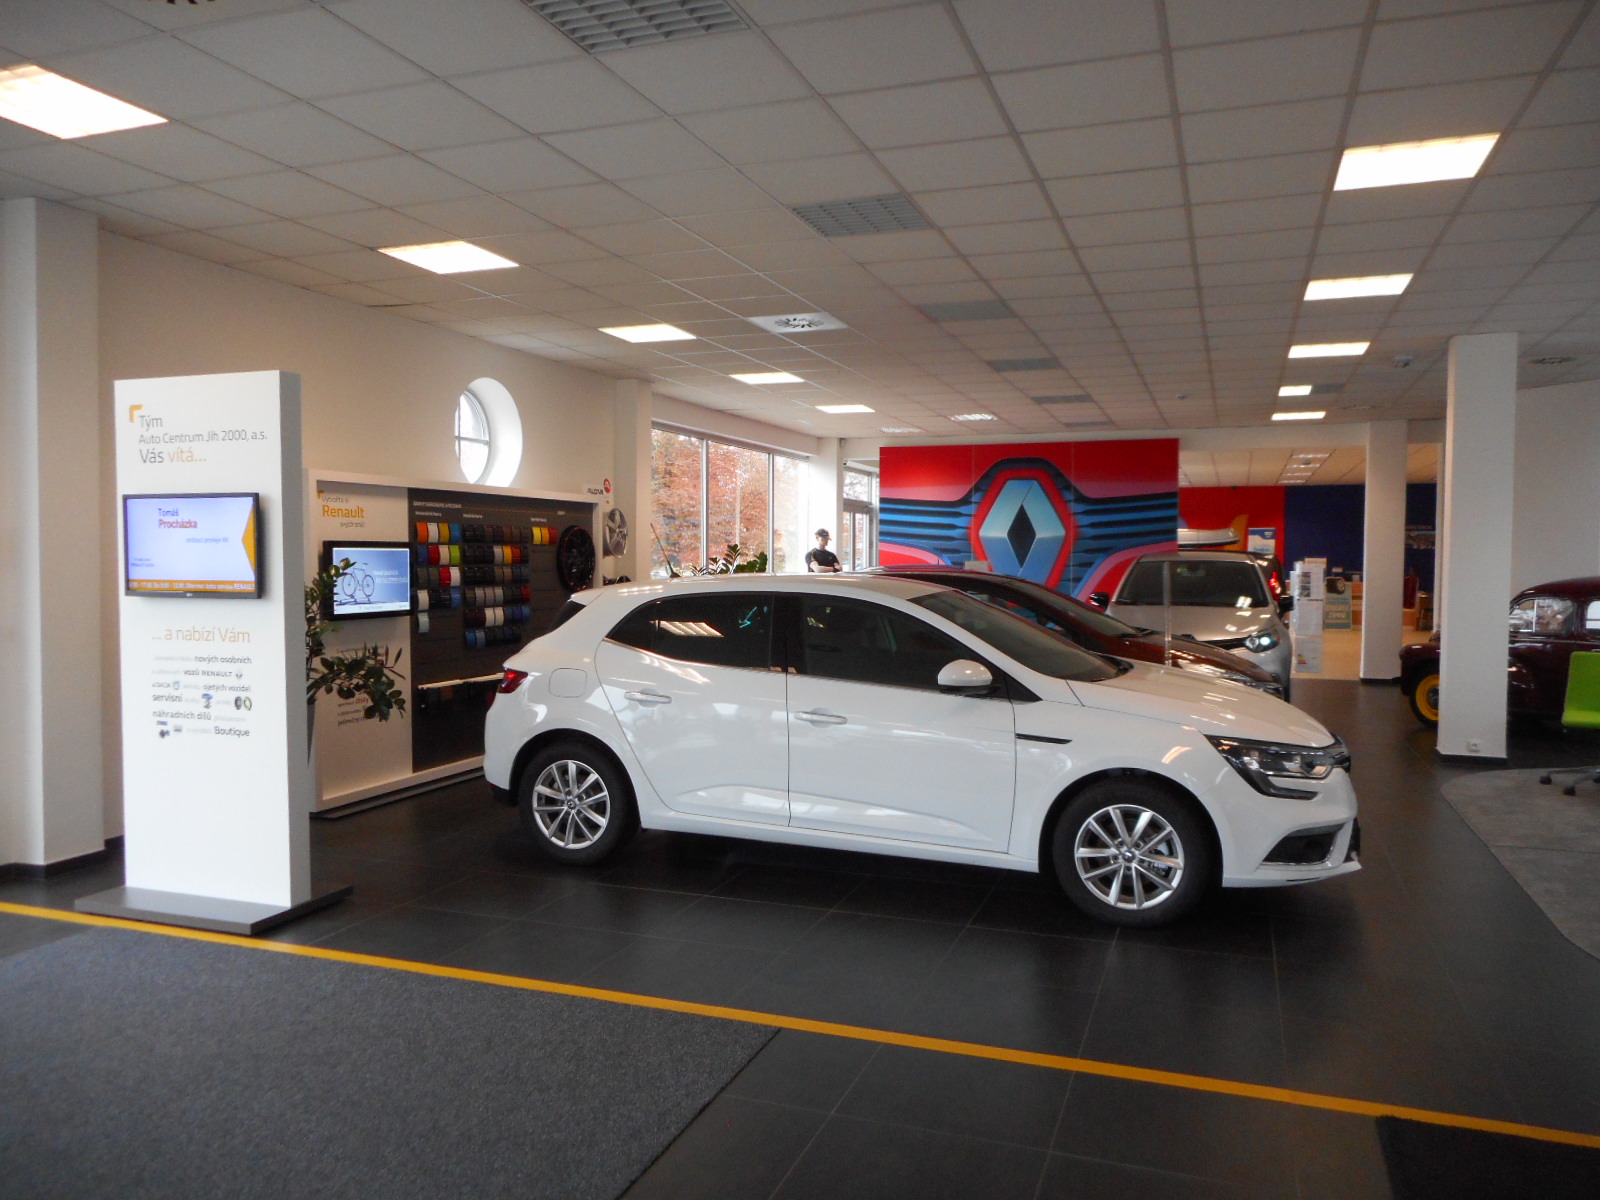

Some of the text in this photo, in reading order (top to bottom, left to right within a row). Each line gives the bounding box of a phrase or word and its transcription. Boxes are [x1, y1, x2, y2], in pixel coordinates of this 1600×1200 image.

[138, 415, 163, 431] Tým
[138, 430, 268, 445] Auto Centrum Jih 2000, a.s.
[139, 447, 207, 464] Vás vítá...
[158, 508, 179, 517] Tomáš
[322, 504, 365, 519] Renault
[159, 518, 198, 529] Procházka
[164, 629, 173, 641] a
[176, 626, 215, 642] nabízí
[218, 626, 251, 643] Vám
[194, 655, 219, 665] nových
[220, 655, 252, 665] osobních
[201, 670, 232, 678] RENAULT
[152, 693, 183, 702] servisní
[152, 709, 195, 719] náhradních
[197, 711, 212, 721] dílů
[214, 726, 250, 738] Boutique
